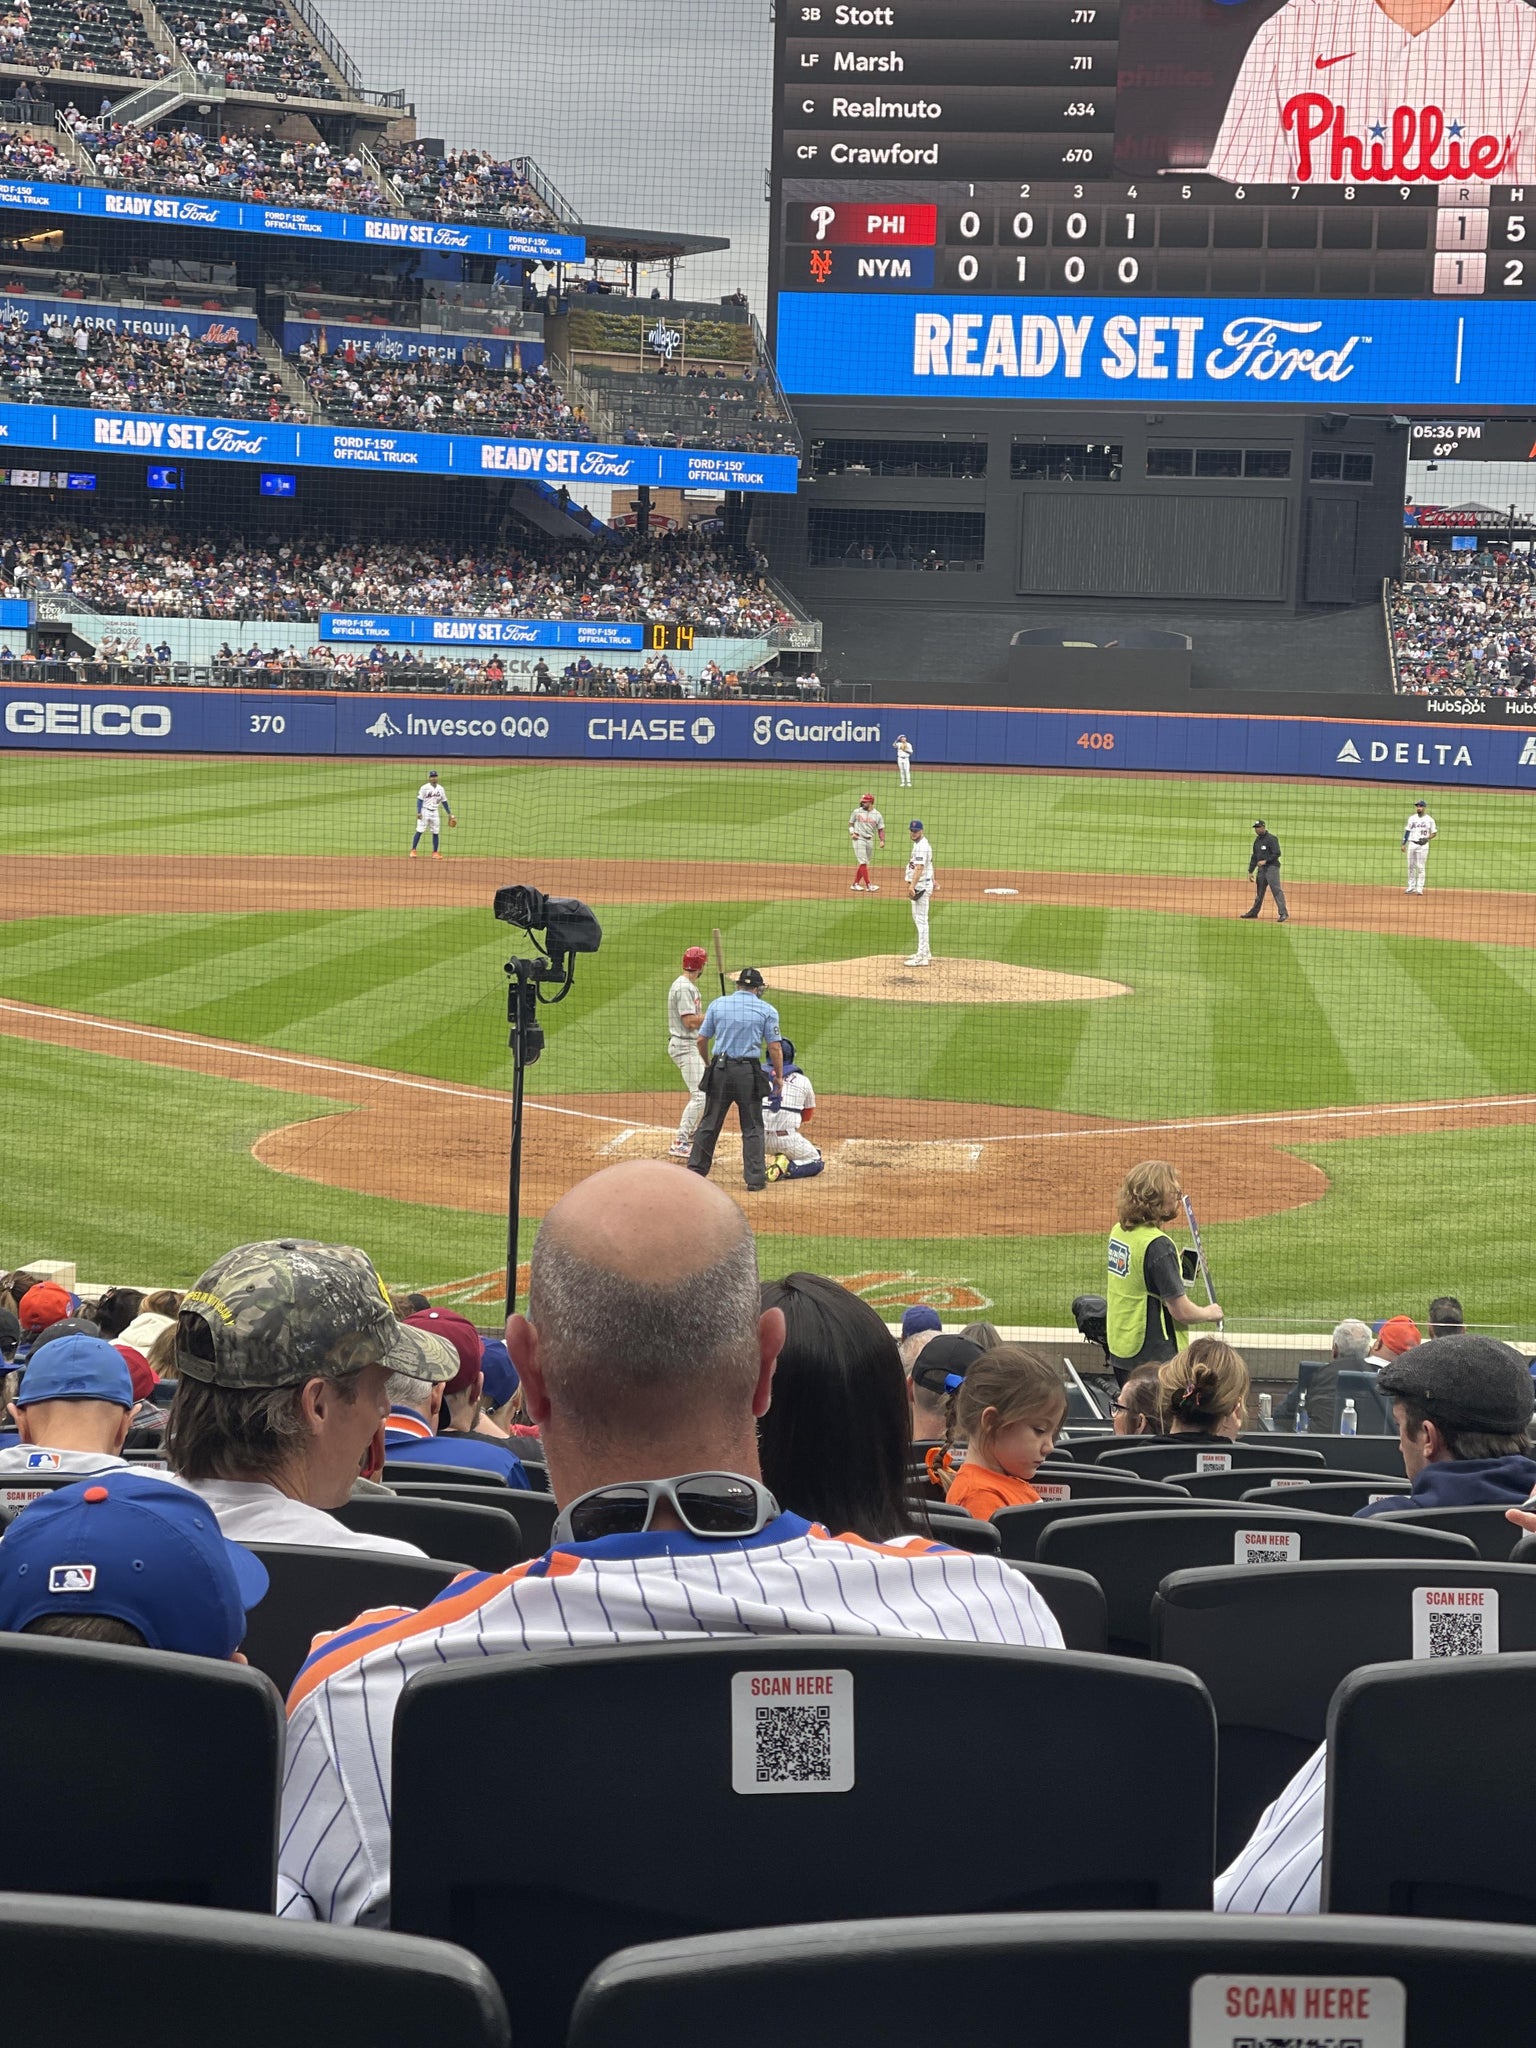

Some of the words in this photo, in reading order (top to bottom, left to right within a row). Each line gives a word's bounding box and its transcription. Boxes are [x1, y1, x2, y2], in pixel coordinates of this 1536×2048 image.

[801, 7, 821, 21] 3B
[835, 5, 894, 26] Stott
[1070, 10, 1096, 24] .717
[801, 54, 819, 67] LF
[833, 51, 904, 72] Marsh
[1069, 57, 1093, 70] .711
[802, 100, 815, 113] C
[832, 97, 942, 119] Realmuto
[1063, 103, 1096, 117] .634
[797, 146, 818, 159] CF
[830, 143, 939, 165] Crawford
[1062, 149, 1093, 163] .670
[23, 195, 50, 206] TRUCK
[968, 184, 975, 197] 1
[1020, 184, 1030, 198] 2
[1074, 185, 1084, 198] 3
[1127, 185, 1138, 199] 4
[1181, 186, 1192, 199] 5
[1235, 186, 1246, 199] 6
[1290, 187, 1300, 200] 7
[1344, 187, 1356, 200] 8
[1400, 187, 1411, 200] 9
[1459, 188, 1470, 201] R
[1510, 188, 1524, 201] H
[106, 194, 151, 217] READY
[153, 199, 180, 219] SET
[180, 202, 217, 222] Ford
[265, 211, 284, 221] FORD
[264, 220, 296, 231] OFFICIAL
[298, 222, 322, 233] TRUCK
[365, 221, 408, 241] READY
[410, 225, 434, 243] SET
[434, 228, 468, 247] Ford
[867, 215, 905, 234] PHI
[959, 211, 981, 239] 0
[1012, 212, 1034, 239] 0
[1066, 212, 1088, 240] 0
[1125, 213, 1135, 240] 1
[1457, 216, 1467, 241] 1
[1506, 215, 1526, 242] 5
[508, 235, 526, 244] FORD
[508, 243, 538, 254] OFFICIAL
[540, 246, 562, 256] TRUCK
[857, 259, 912, 278] NYM
[958, 254, 979, 281] 0
[1016, 256, 1026, 282] 1
[1064, 256, 1086, 282] 0
[1117, 257, 1139, 283] 0
[1455, 260, 1465, 285] 1
[1503, 260, 1524, 286] 2
[43, 312, 117, 331] MILAGRO
[122, 319, 190, 338] TEQUILA
[342, 339, 371, 353] THE
[408, 344, 457, 360] PORCH
[913, 312, 1095, 378] READY
[1101, 314, 1204, 380] SET
[1205, 316, 1360, 382] Ford
[94, 417, 165, 447] READY
[167, 423, 207, 450] SET
[206, 426, 262, 454] Ford
[334, 436, 364, 448] FORD
[1413, 425, 1454, 439] 05:36
[1457, 426, 1481, 439] PM
[333, 448, 381, 462] OFFICIAL
[383, 451, 418, 464] TRUCK
[481, 445, 543, 472] READY
[545, 448, 580, 474] SET
[580, 451, 629, 477] Ford
[689, 458, 714, 469] FORD
[688, 470, 731, 483] OFFICIAL
[732, 472, 764, 484] TRUCK
[1418, 507, 1478, 527] Coors
[332, 618, 352, 627] FORD
[332, 627, 365, 636] OFFICIAL
[365, 628, 389, 637] TRUCK
[433, 621, 478, 639] READY
[478, 623, 502, 641] SET
[502, 624, 536, 642] Ford
[578, 627, 596, 636] FORD
[577, 635, 608, 644] OFFICIAL
[609, 636, 632, 645] TRUCK
[1427, 698, 1486, 715] HubSpot
[5, 702, 171, 736] GEICO
[249, 714, 286, 734] 370
[407, 713, 497, 737] Invesco
[501, 716, 550, 739] QQQ
[588, 717, 686, 741] CHASE
[775, 720, 880, 742] Guardian
[1076, 732, 1115, 750] 408
[1371, 741, 1473, 767] DELTA
[6, 1491, 27, 1500] SCAN
[1049, 1486, 1063, 1494] HERE
[1245, 1533, 1267, 1545] SCAN
[1268, 1534, 1290, 1546] HERE
[1426, 1591, 1456, 1606] SCAN
[1457, 1592, 1485, 1606] HERE
[751, 1677, 791, 1696] SCAN
[796, 1676, 833, 1695] HERE
[1225, 1986, 1296, 2018] SCAN
[1304, 1988, 1370, 2019] HERE
